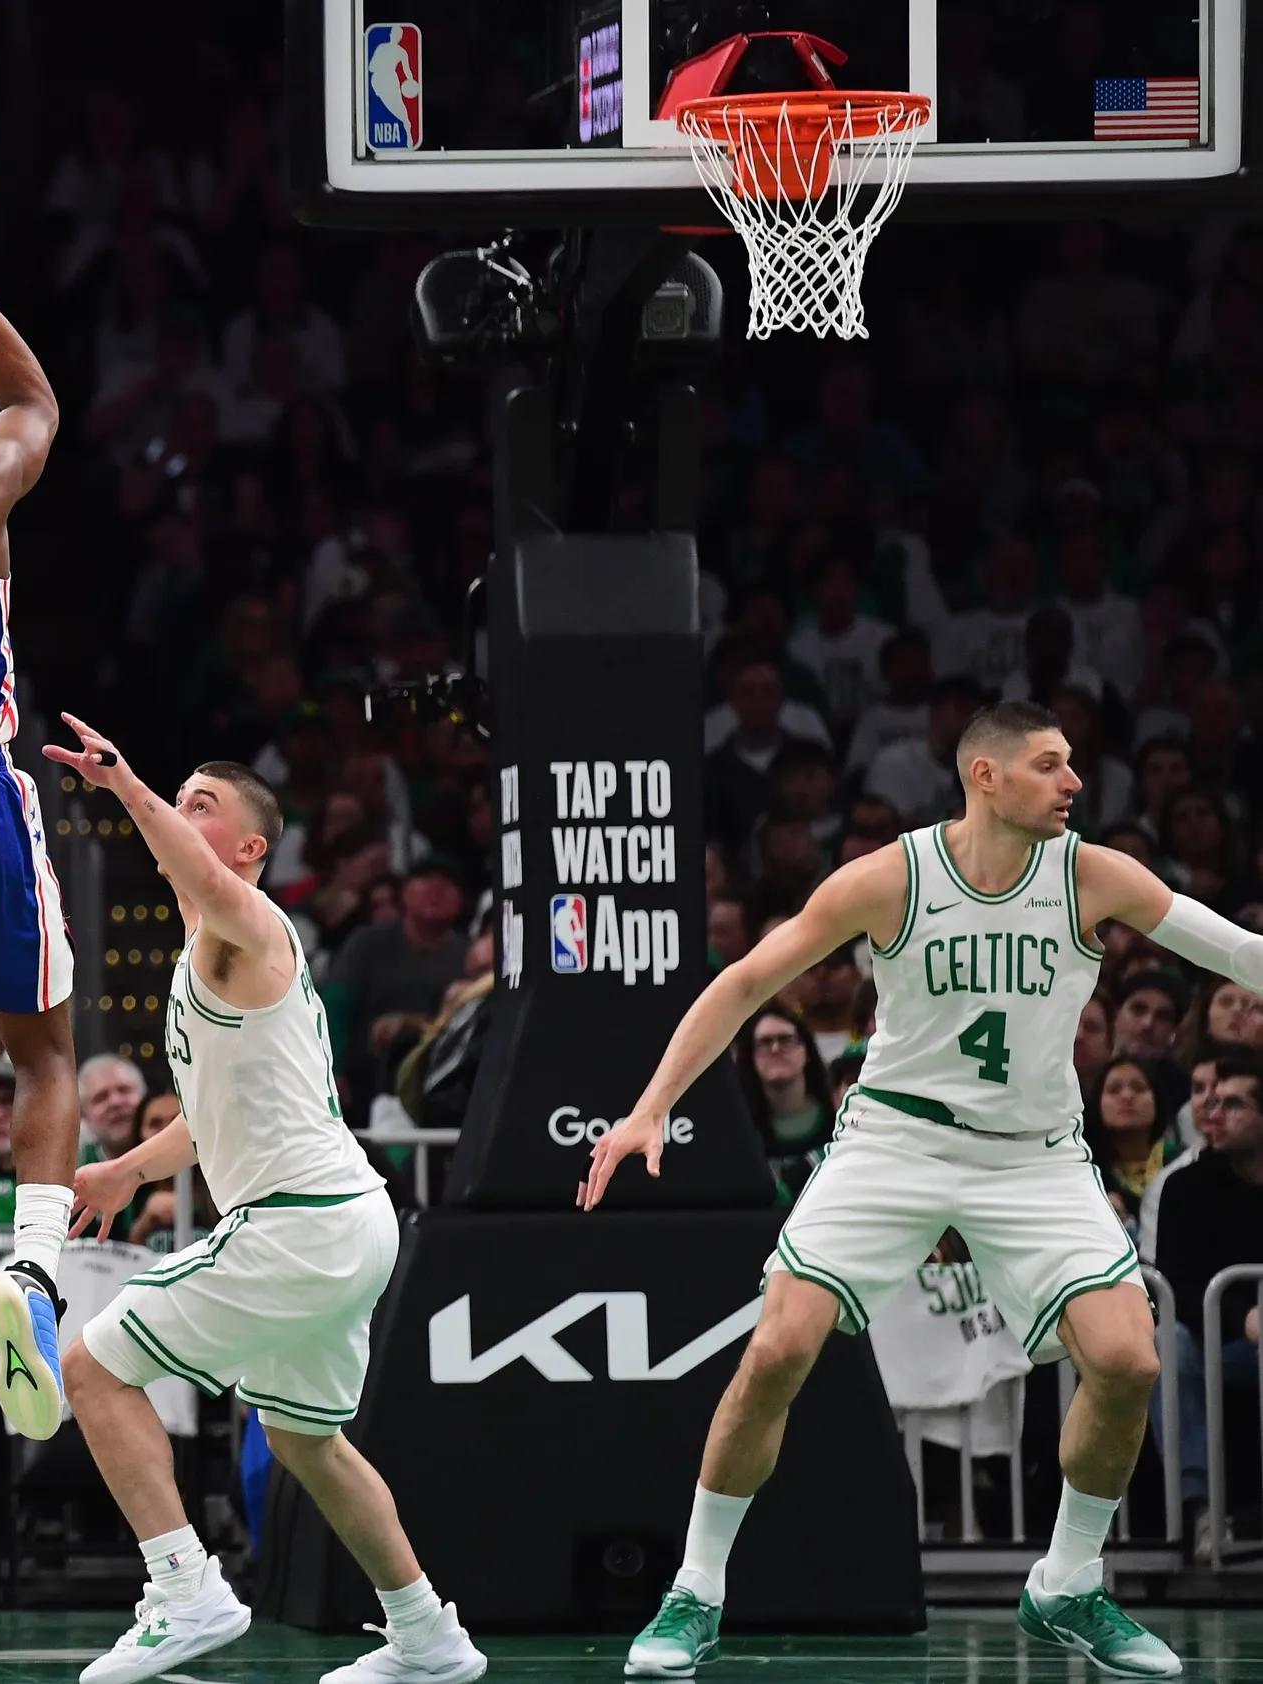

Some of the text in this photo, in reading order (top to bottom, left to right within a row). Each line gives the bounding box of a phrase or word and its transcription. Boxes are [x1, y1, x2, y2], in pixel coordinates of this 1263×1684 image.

[374, 123, 400, 143] NBA
[550, 761, 617, 819] TAP
[624, 760, 672, 818] TO
[551, 825, 676, 884] WATCH
[1024, 896, 1062, 909] Amica
[593, 894, 680, 986] App
[924, 932, 1059, 997] CELTICS
[958, 1011, 1010, 1085] 4
[548, 1106, 694, 1146] Gole
